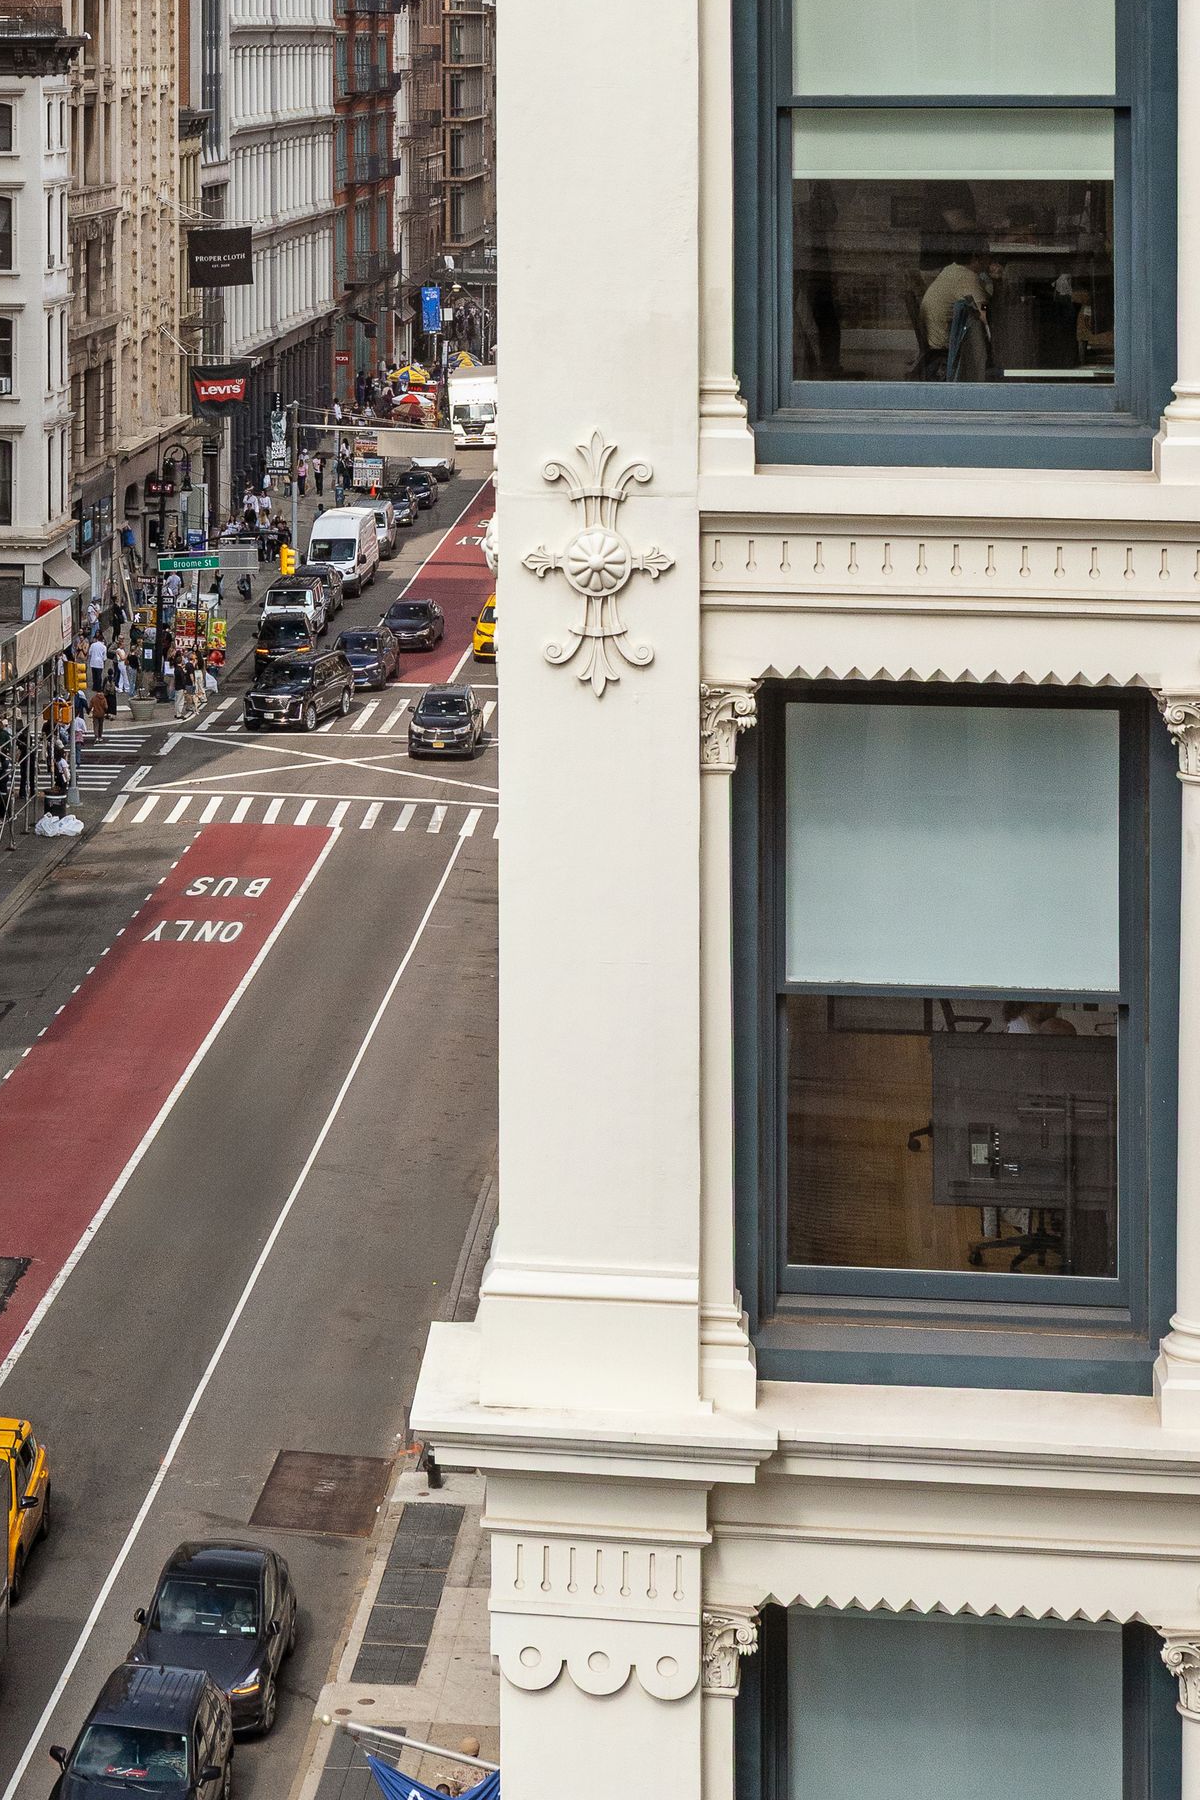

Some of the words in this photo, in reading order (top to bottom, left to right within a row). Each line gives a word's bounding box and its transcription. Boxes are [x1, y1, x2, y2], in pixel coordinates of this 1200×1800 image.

[222, 252, 246, 261] CLOTH
[186, 877, 271, 898] BUS
[142, 920, 244, 942] ONLY
